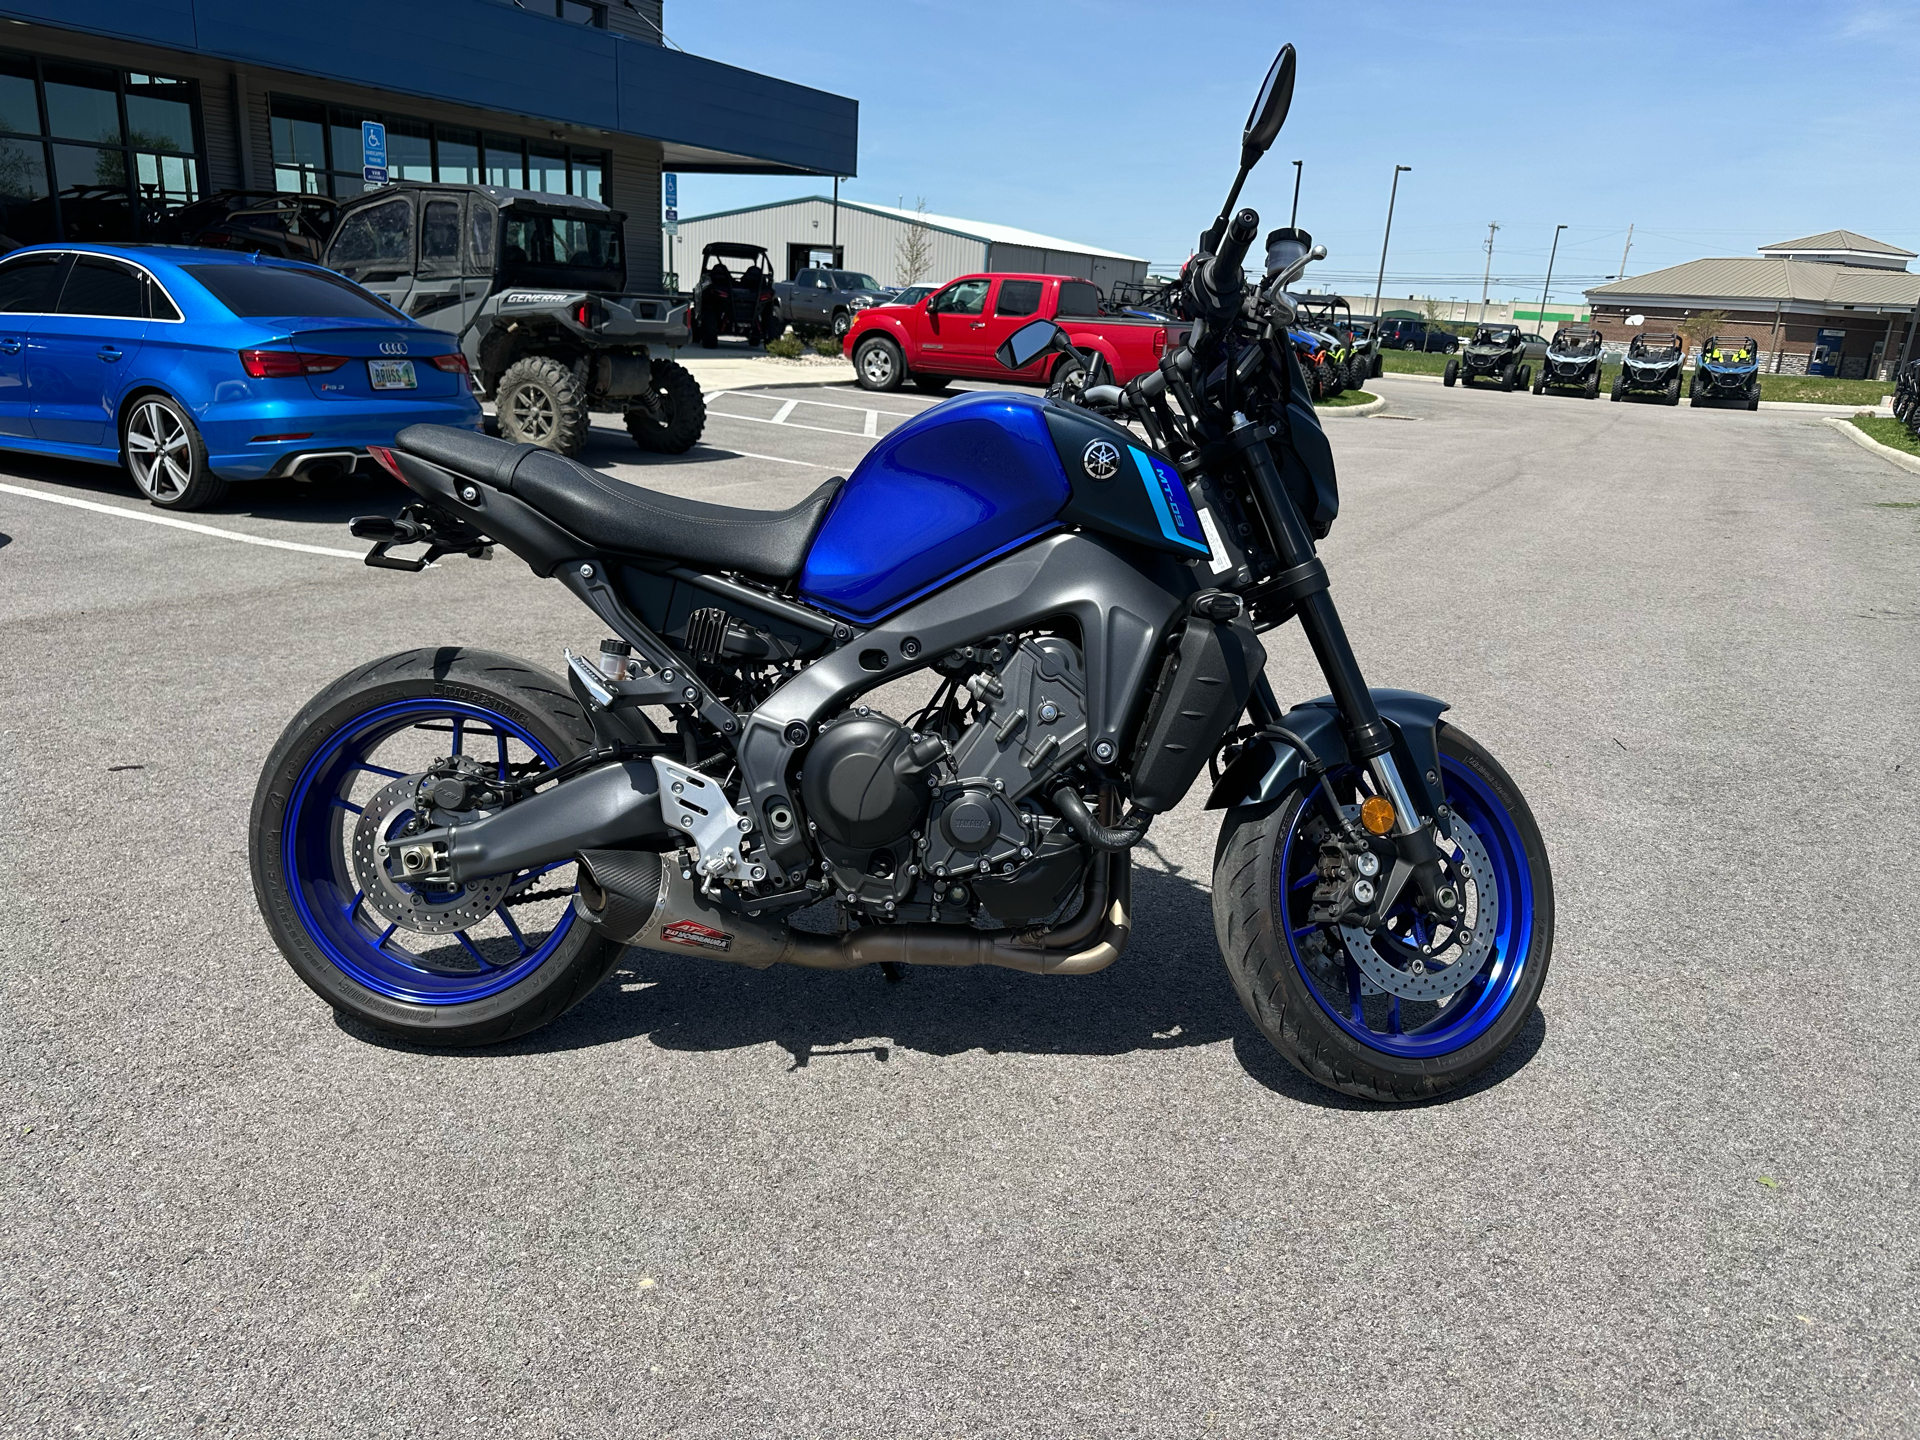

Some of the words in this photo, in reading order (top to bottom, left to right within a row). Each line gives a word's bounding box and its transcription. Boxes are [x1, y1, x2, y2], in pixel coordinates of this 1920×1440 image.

[507, 293, 568, 303] GENERAL
[375, 368, 402, 384] BRUSS
[405, 369, 412, 383] 1
[1156, 468, 1185, 528] MT-09
[433, 682, 529, 724] BRIDGESTONE
[955, 818, 985, 828] YAMAHA
[677, 931, 727, 948] YOSHIMURA
[1528, 924, 1545, 975] BATTLAX
[338, 983, 434, 1023] BRIDGESTONE
